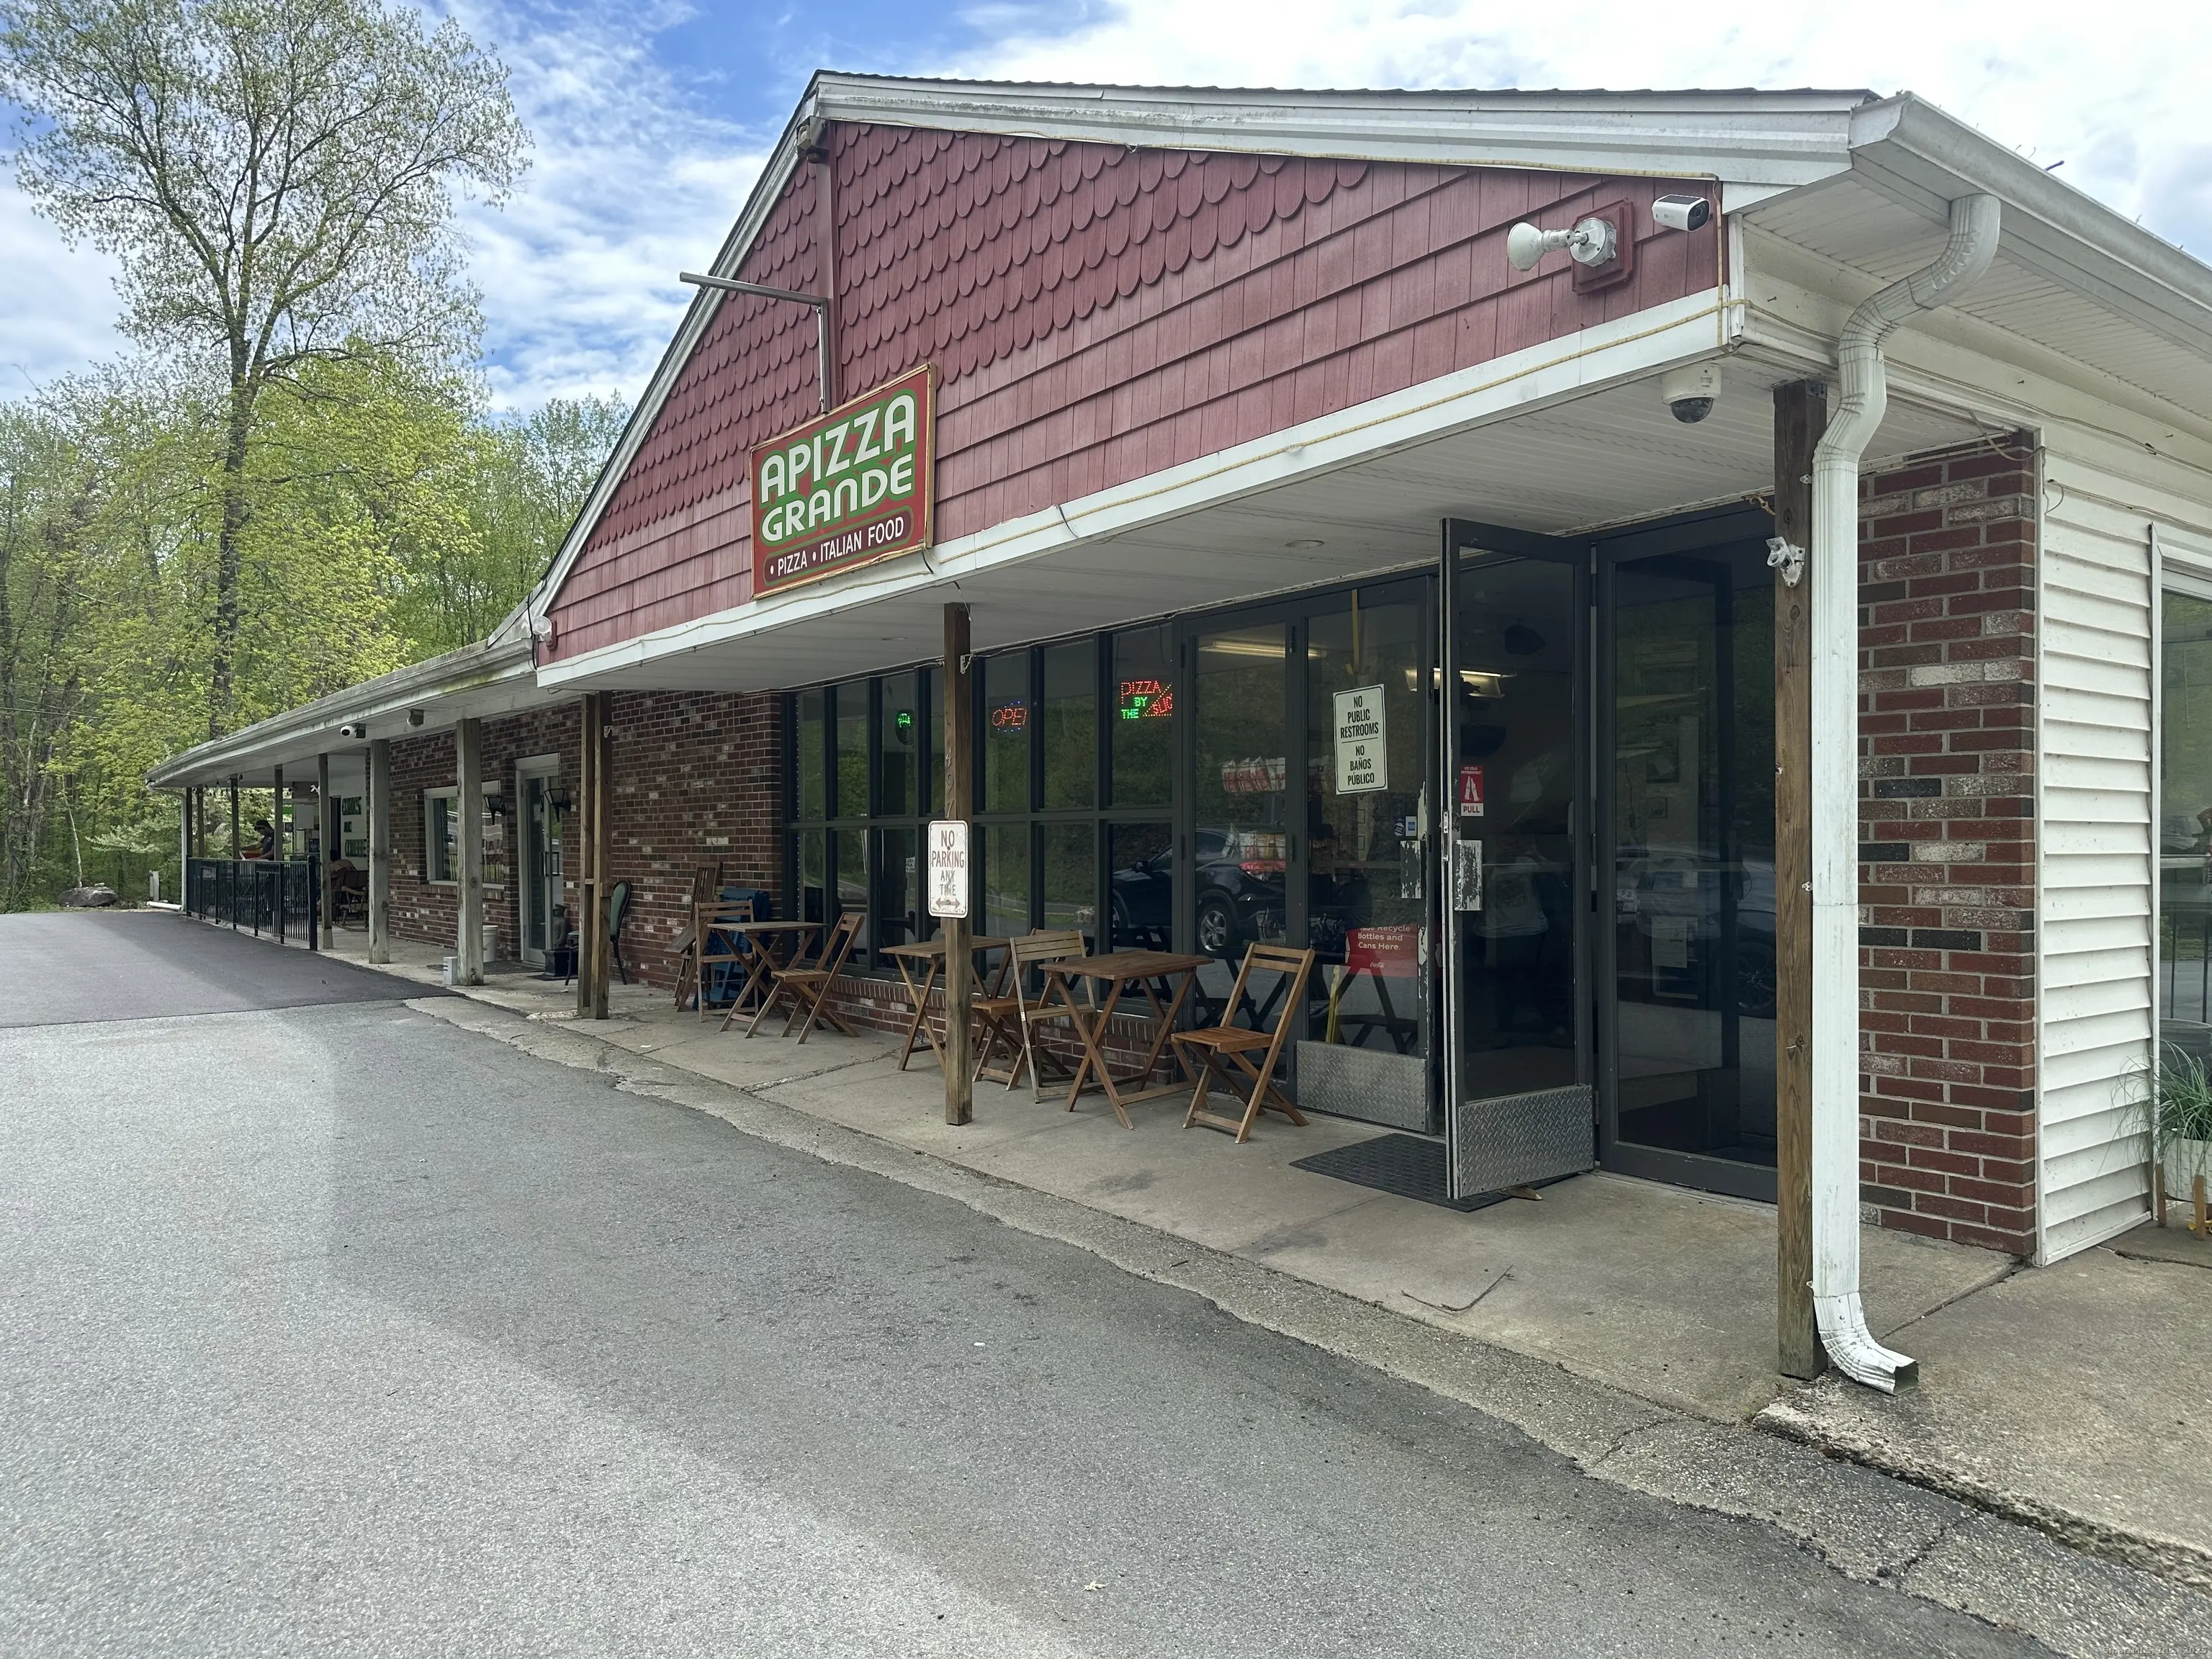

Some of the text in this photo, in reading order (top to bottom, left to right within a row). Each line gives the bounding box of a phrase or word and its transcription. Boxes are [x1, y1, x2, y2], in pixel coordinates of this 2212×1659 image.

[761, 395, 914, 503] APIZZA
[762, 453, 912, 541] GRANDE
[778, 516, 904, 577] PIZZA ITALIAN FOOD
[1121, 680, 1161, 704] PIZZA
[1134, 696, 1148, 707] BY
[1354, 695, 1363, 708] NO
[1121, 709, 1139, 719] THE
[1347, 709, 1370, 724] PUBLIC
[1340, 721, 1379, 739] RESTROOMS
[1355, 745, 1364, 756] NO
[1349, 757, 1372, 772] BAÑOS
[1347, 772, 1375, 786] PÚBLICO
[940, 830, 955, 848] NO
[932, 850, 964, 868] PARKING
[940, 870, 956, 883] ANY
[940, 884, 956, 896] TIME
